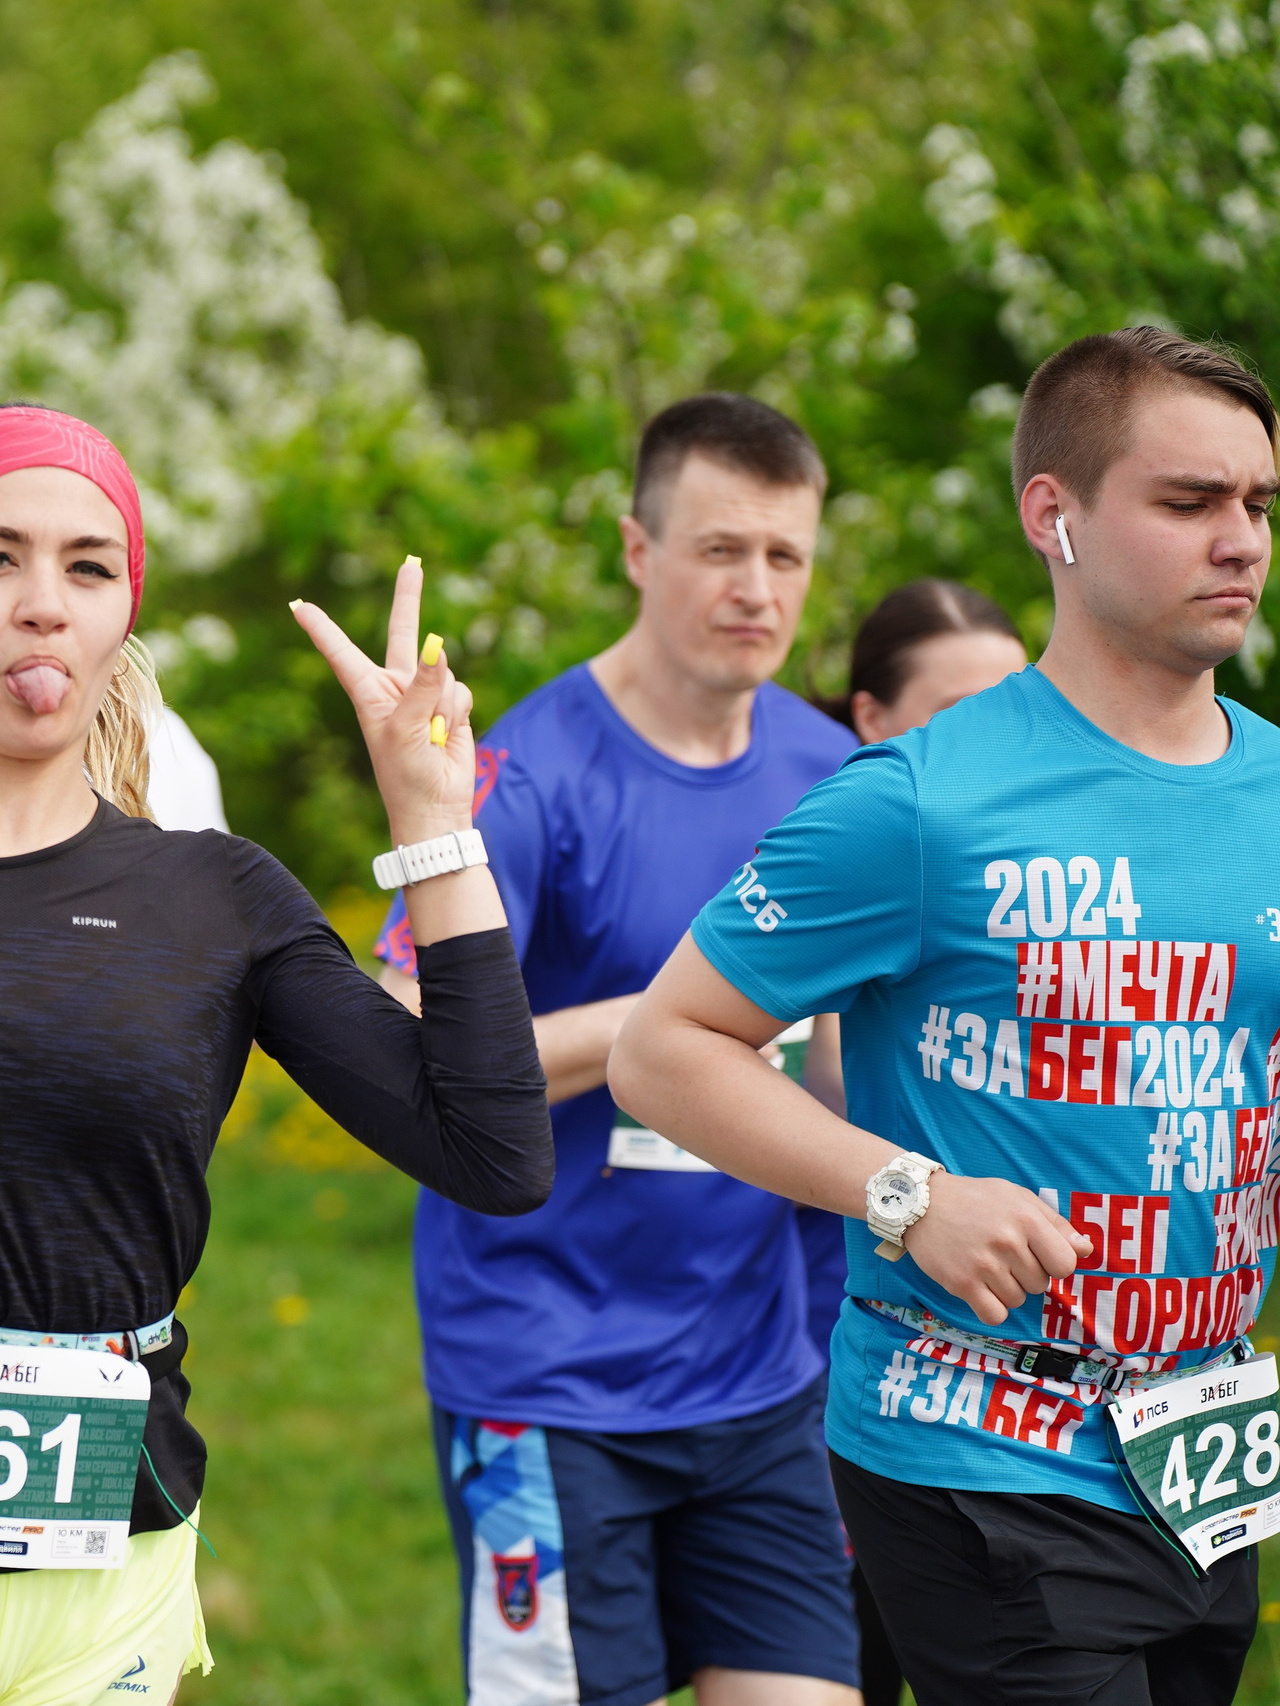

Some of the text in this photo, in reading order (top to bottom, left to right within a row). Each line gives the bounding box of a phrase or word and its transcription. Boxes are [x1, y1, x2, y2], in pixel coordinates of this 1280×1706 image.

[72, 916, 117, 928] KIPRUN
[734, 862, 788, 932] ПСБ
[984, 856, 1142, 937] 2024
[1018, 942, 1231, 1021] #МЕЧТА
[918, 1004, 1251, 1108] #ЗАБЕГ2024
[878, 1350, 1084, 1454] #ЗАБЕГ
[1147, 1401, 1169, 1420] ПСБ
[1160, 1410, 1280, 1513] 428
[58, 1529, 67, 1537] 10
[1240, 1508, 1257, 1518] PRO
[107, 1682, 151, 1693] DEMIX
